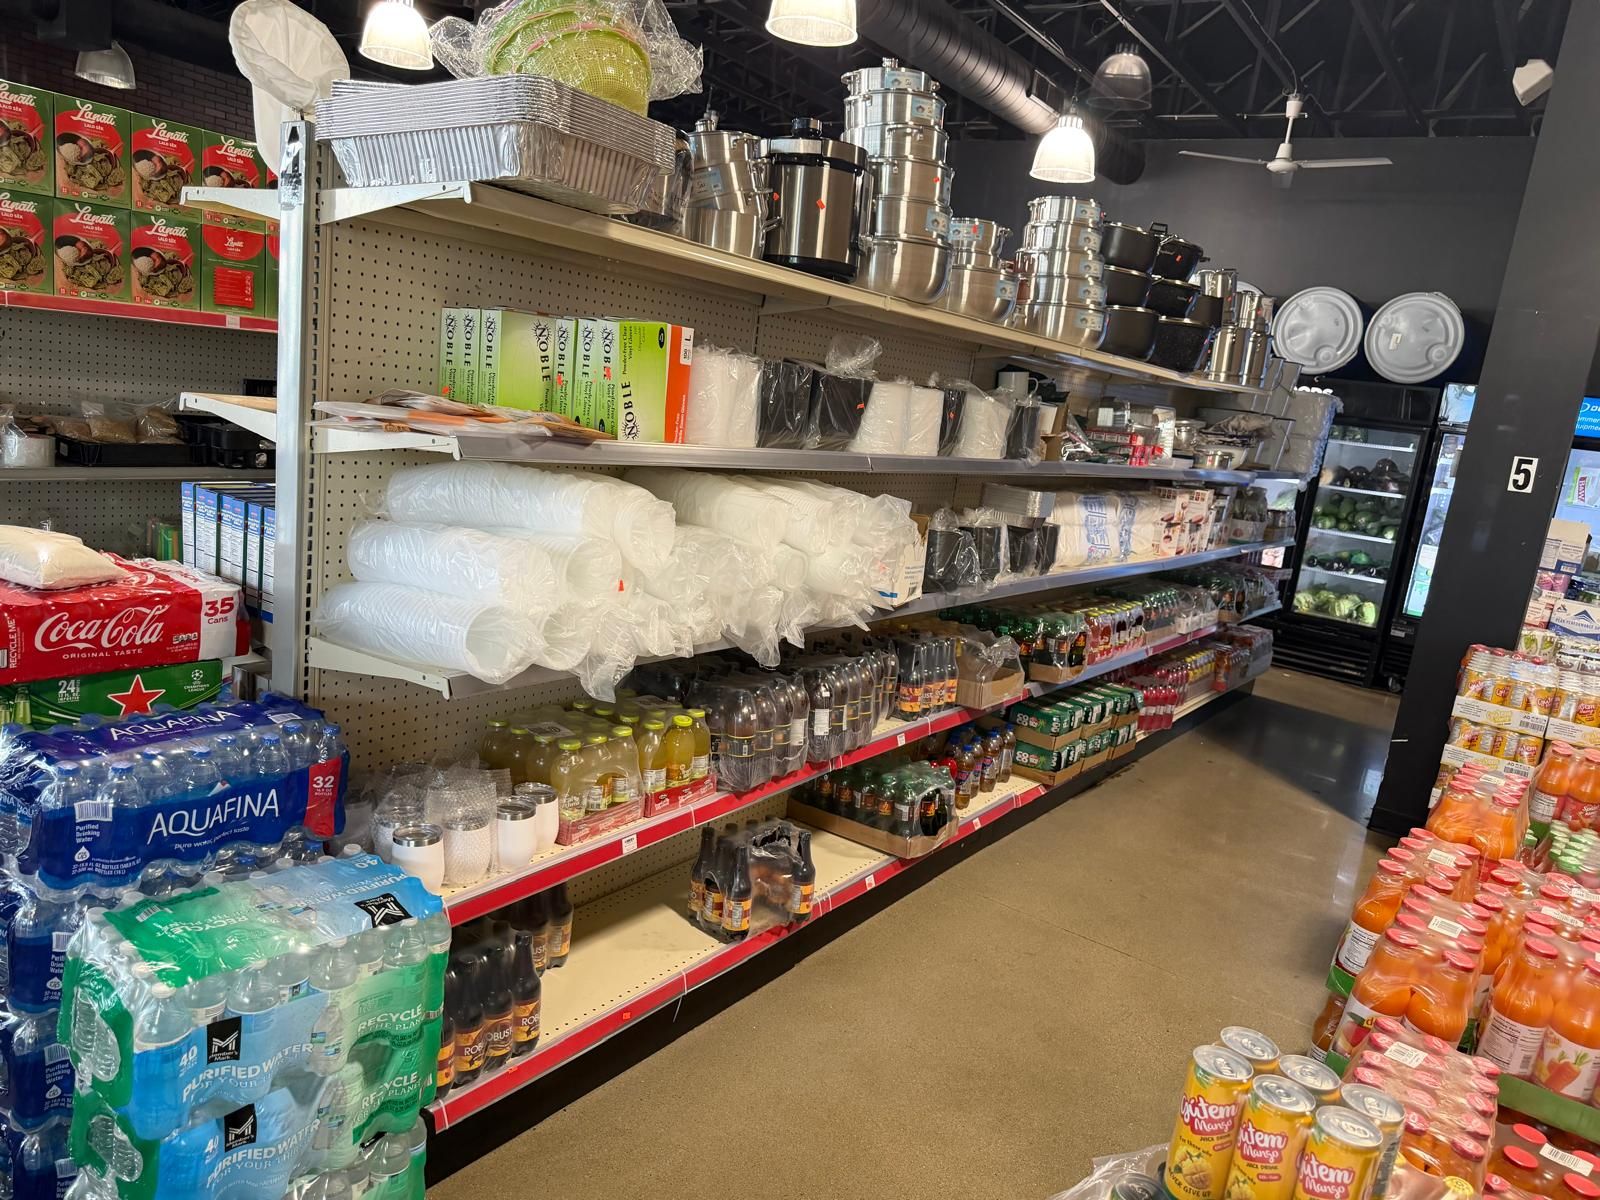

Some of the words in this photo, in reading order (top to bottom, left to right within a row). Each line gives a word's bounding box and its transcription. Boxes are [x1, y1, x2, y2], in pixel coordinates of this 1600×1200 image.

[446, 317, 456, 366] NOBLE
[463, 318, 474, 367] NOBLE
[485, 320, 496, 369] NOBLE
[536, 325, 552, 383] NOBLE
[582, 329, 592, 378] NOBLE
[621, 381, 637, 440] NOBLE
[1512, 459, 1534, 491] 5
[204, 596, 235, 618] 35
[34, 604, 171, 653] Coca-Cola
[207, 615, 229, 625] Cans
[9, 633, 17, 669] RECYCLE
[62, 651, 111, 660] ORIGINAL
[114, 648, 143, 656] TASTE
[58, 680, 76, 693] 24
[110, 711, 240, 741] AQUAFINA
[312, 775, 335, 788] 32
[147, 788, 280, 845] AQUAFINA
[75, 830, 101, 838] Drinking
[174, 843, 192, 851] pure
[355, 859, 379, 869] 40
[346, 873, 409, 895] PURIFIED
[358, 1003, 422, 1033] RECYCLE
[178, 1045, 198, 1067] 40
[45, 1062, 70, 1074] Purified
[45, 1068, 71, 1080] Drinking
[182, 1064, 261, 1104] PURIFIED
[262, 1042, 314, 1073] WATER
[45, 1075, 64, 1085] Water
[219, 1077, 257, 1088] YOUR
[1194, 1118, 1233, 1133] Mango
[204, 1135, 219, 1154] 40
[1243, 1144, 1279, 1163] Mango
[206, 1147, 276, 1189] PURIFIED
[236, 1160, 272, 1170] YOUR
[1182, 1185, 1200, 1197] GIVE
[1201, 1190, 1213, 1198] UP
[1305, 1176, 1346, 1199] Mango
